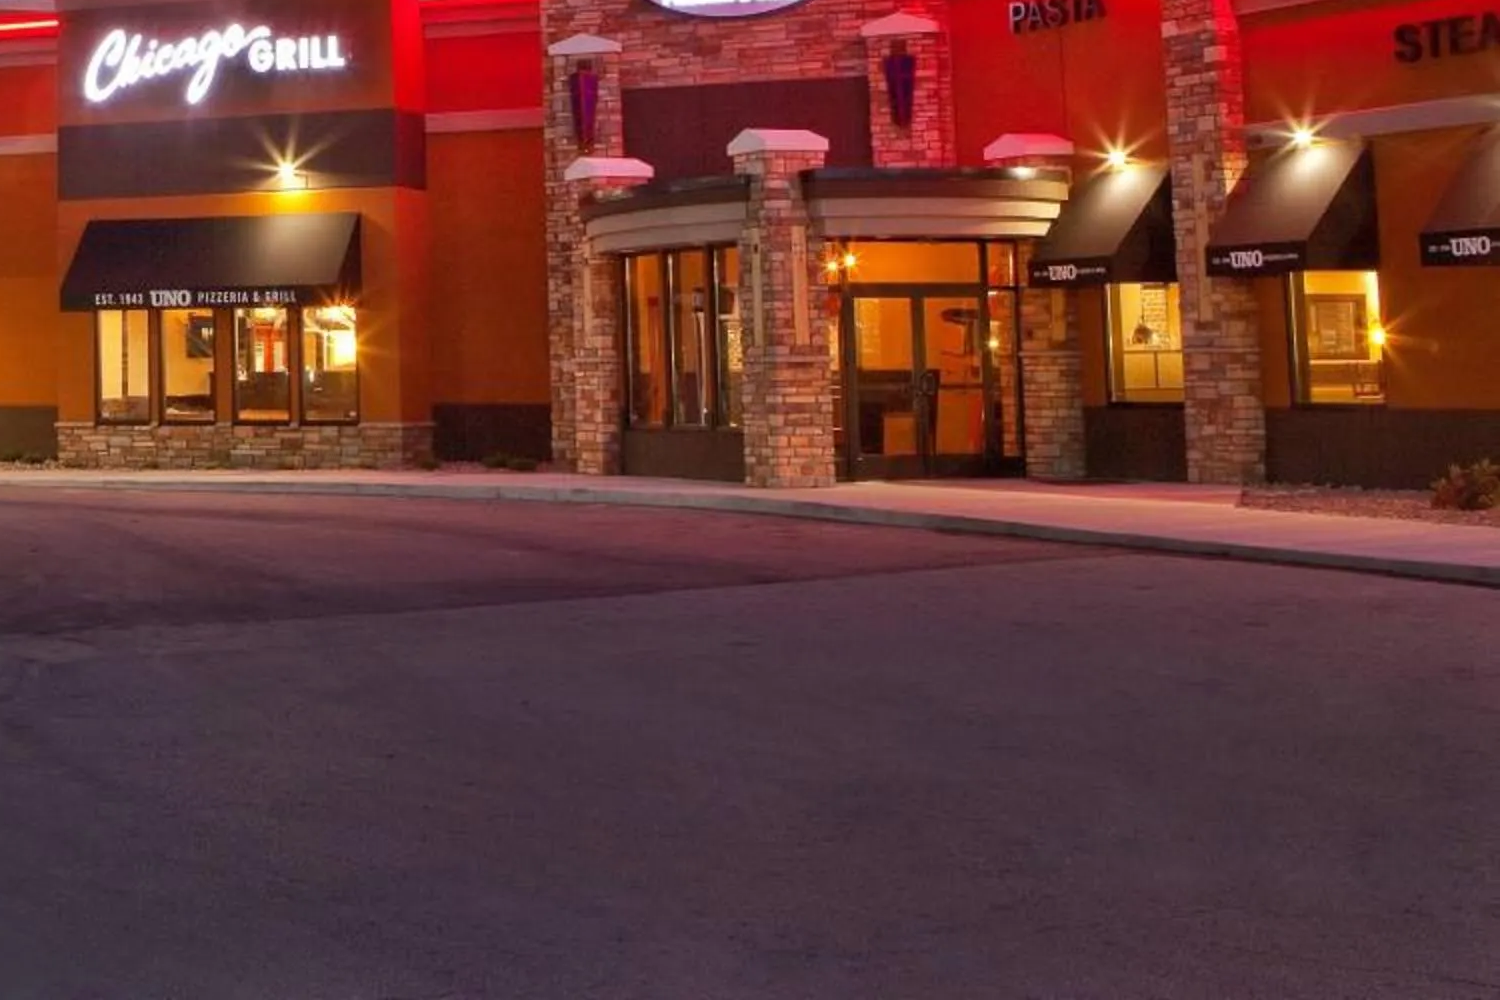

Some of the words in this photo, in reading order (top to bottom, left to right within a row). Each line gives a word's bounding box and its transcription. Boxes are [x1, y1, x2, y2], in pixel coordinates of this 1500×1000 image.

[84, 23, 272, 104] Chicago
[247, 36, 345, 72] GRILL
[1449, 236, 1491, 257] UNO
[1229, 250, 1262, 269] UNO
[1048, 264, 1077, 281] UNO
[149, 289, 192, 307] UNO
[197, 291, 249, 303] PIZZERIA
[265, 290, 297, 303] GRILL
